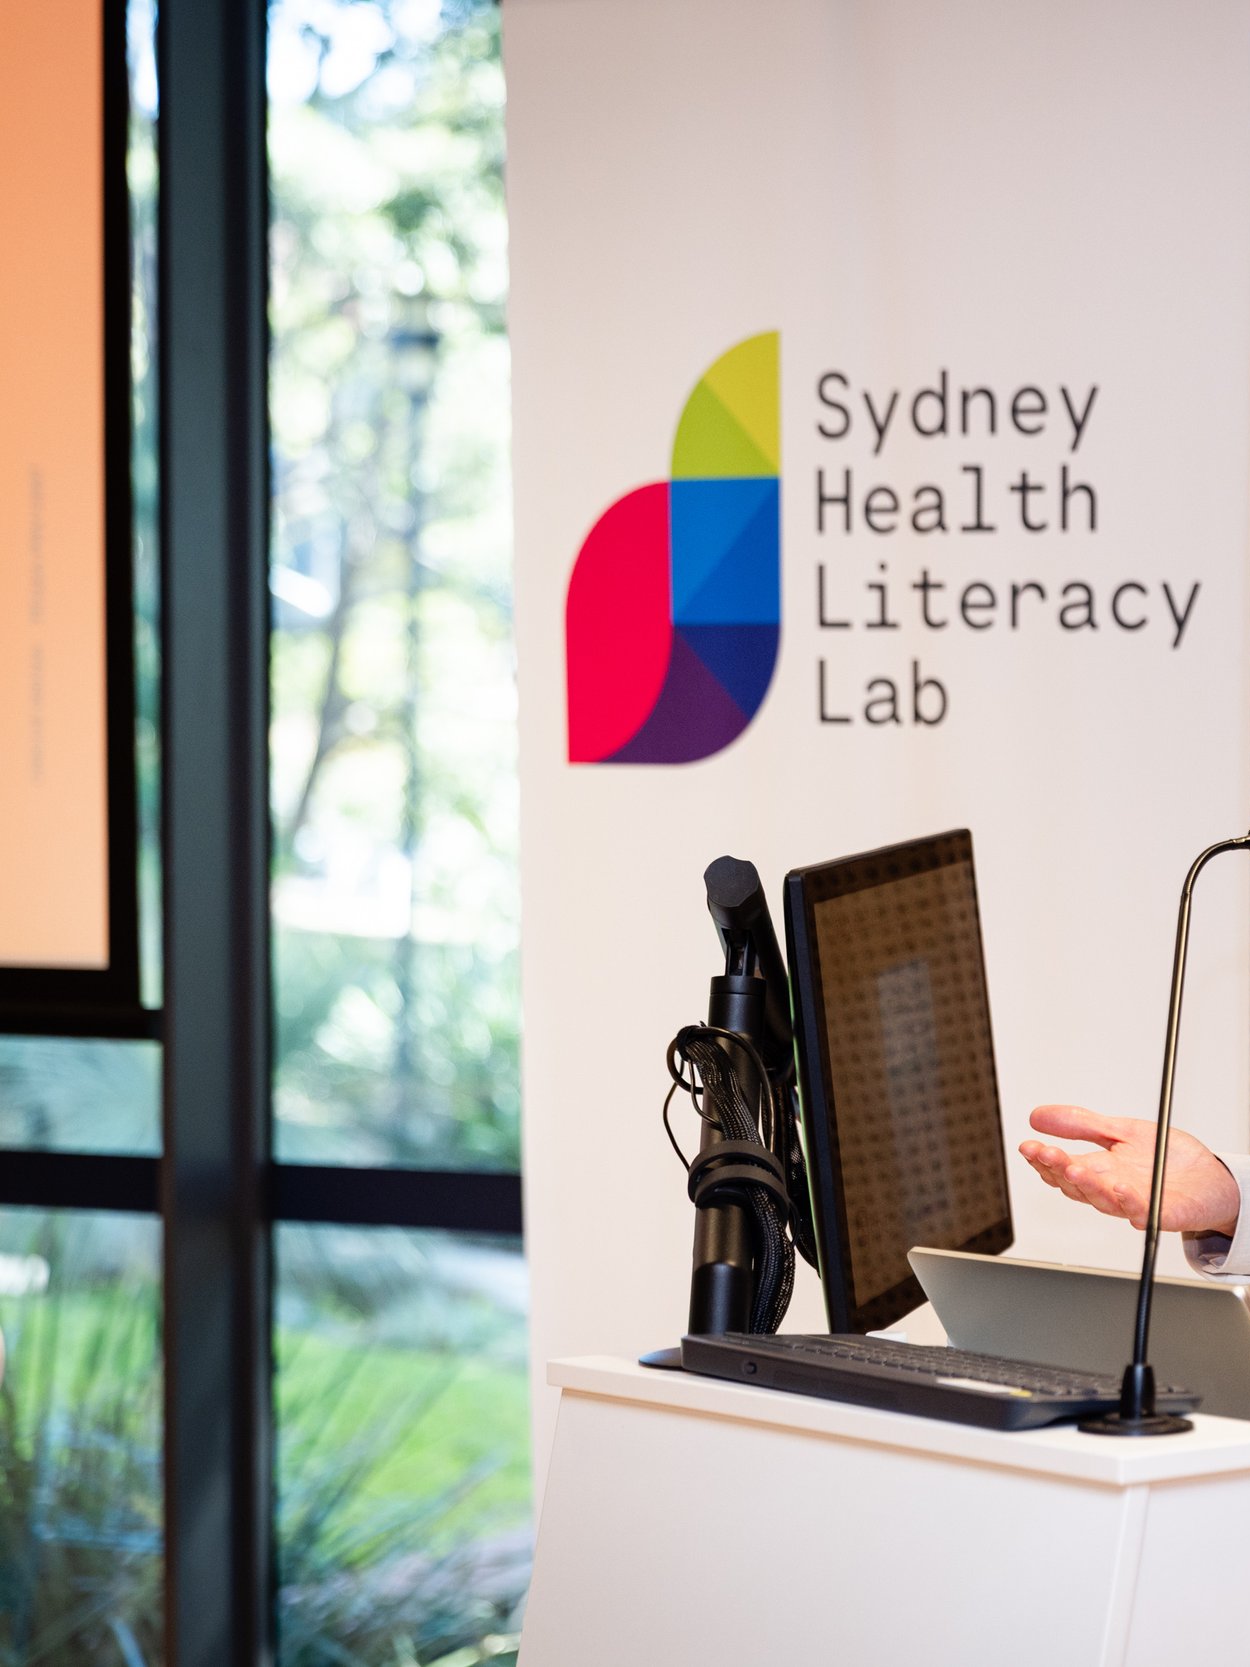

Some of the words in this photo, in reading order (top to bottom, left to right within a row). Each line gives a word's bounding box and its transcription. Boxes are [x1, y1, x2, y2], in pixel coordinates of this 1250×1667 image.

[816, 369, 1099, 455] Sydney
[816, 465, 1097, 534] Health
[817, 563, 1201, 649] Literacy
[818, 657, 949, 727] Lab
